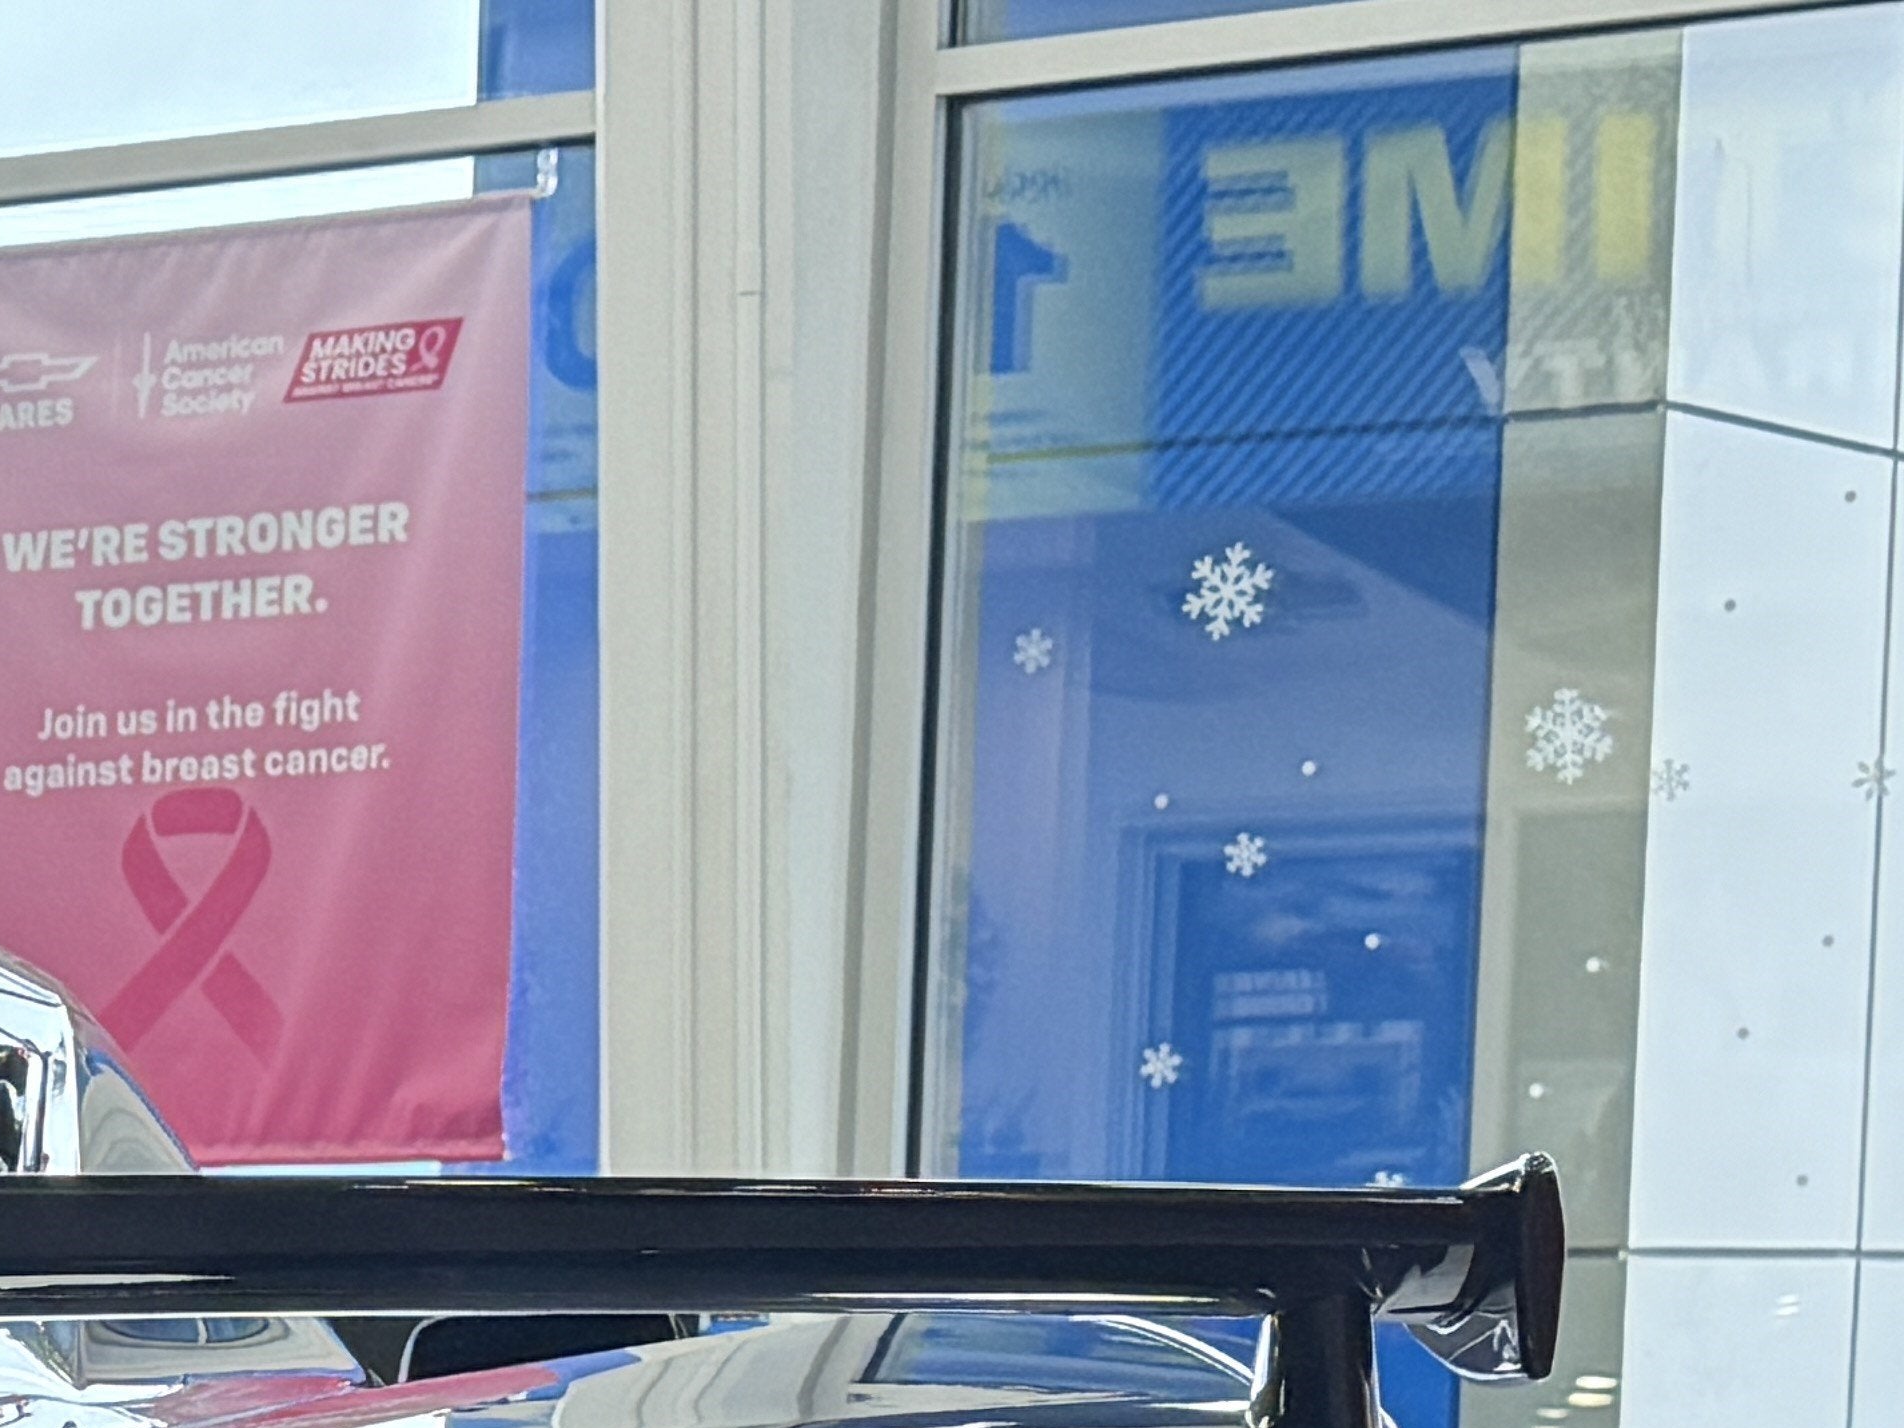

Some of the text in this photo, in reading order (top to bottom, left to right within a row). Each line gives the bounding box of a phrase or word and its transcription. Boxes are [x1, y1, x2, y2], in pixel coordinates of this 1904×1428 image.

[164, 333, 284, 364] American
[309, 328, 416, 359] MAKING
[161, 363, 254, 390] Cancer
[300, 353, 408, 383] STRIDES
[161, 388, 257, 416] Society
[3, 503, 411, 572] WE'RE STRONGER
[76, 574, 329, 631] TOGETHER.
[37, 690, 360, 740] Join us in the fight
[4, 742, 390, 795] against breast cancer.
